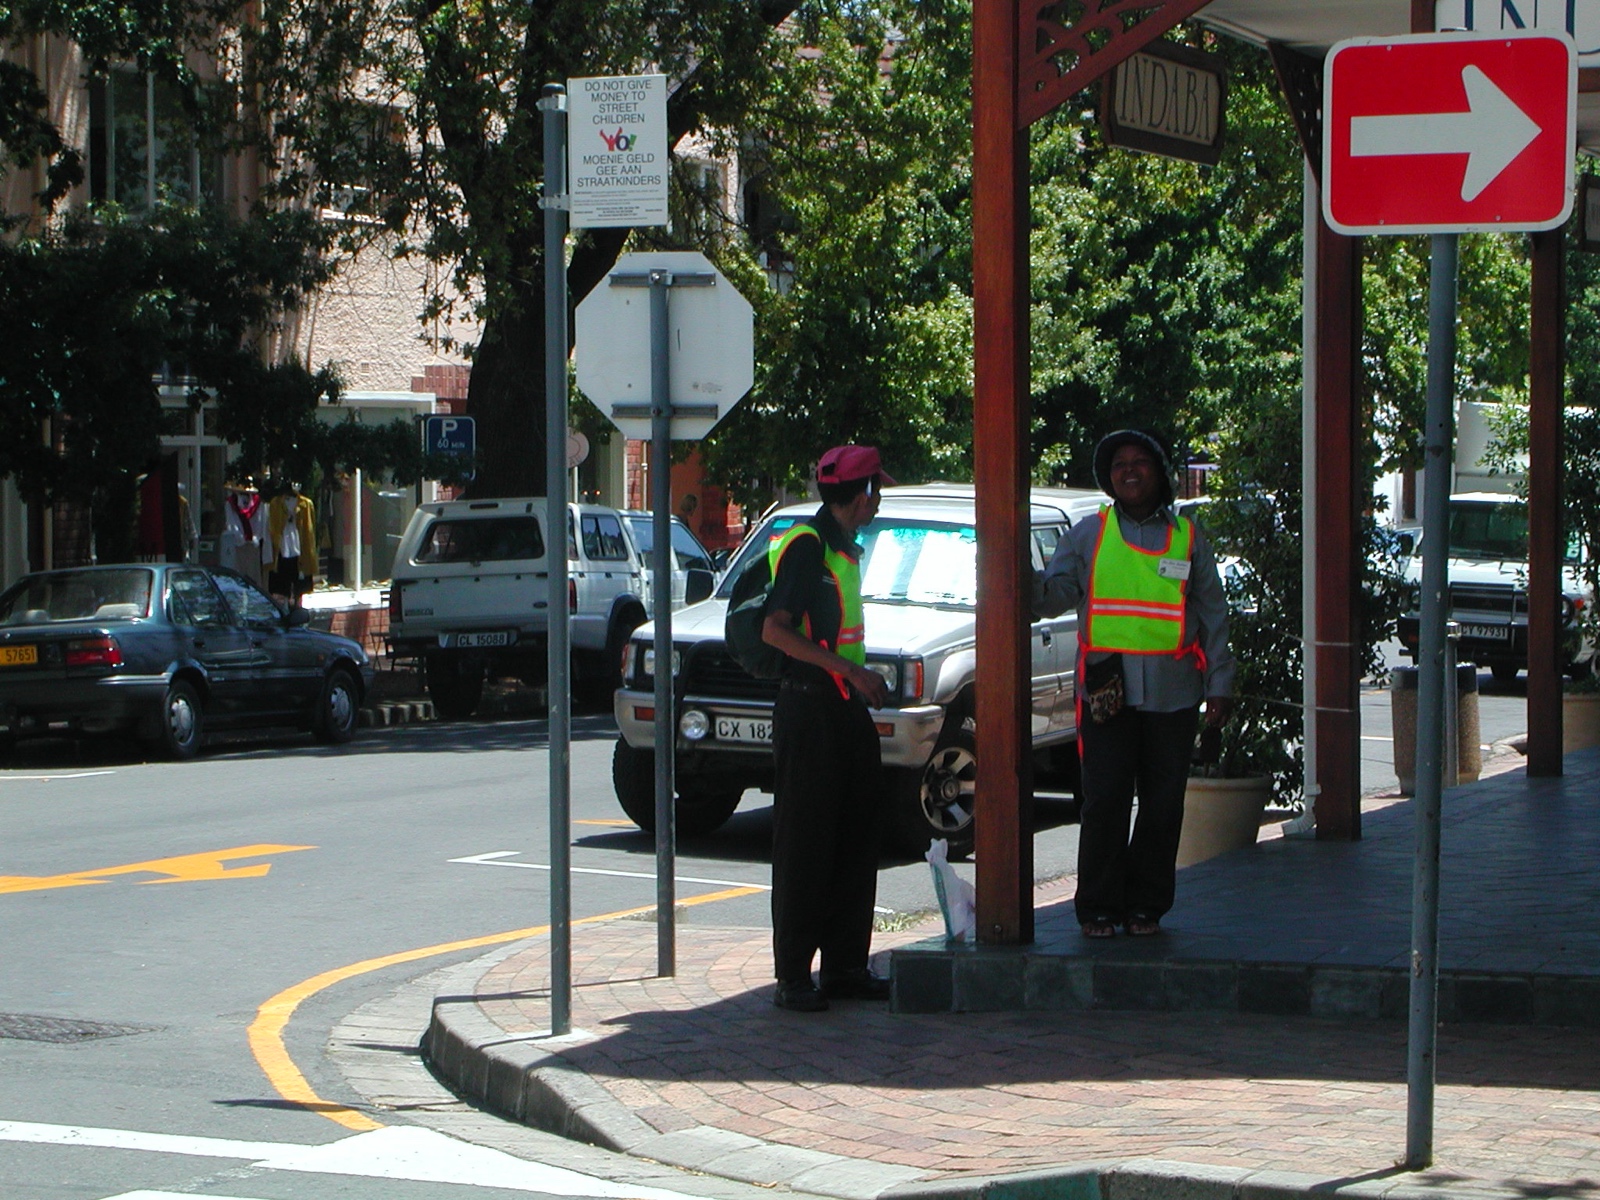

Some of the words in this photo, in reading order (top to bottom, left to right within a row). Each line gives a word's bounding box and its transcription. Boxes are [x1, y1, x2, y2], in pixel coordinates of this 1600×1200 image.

[584, 81, 601, 92] DO
[603, 80, 626, 91] NOT
[627, 79, 652, 90] GIVE
[591, 91, 629, 103] MONEY
[631, 90, 646, 101] TO
[1119, 56, 1210, 140] INDABA
[598, 102, 638, 113] STREET
[592, 113, 645, 125] CHILDREN
[583, 154, 623, 165] MOENIE
[626, 153, 655, 164] GELD
[596, 165, 618, 176] GEE
[620, 164, 642, 175] AAN
[577, 175, 661, 188] STRAATKINDERS
[442, 419, 458, 438] P
[437, 439, 449, 449] 60
[459, 635, 473, 646] CL
[476, 634, 506, 646] 15088
[5, 647, 35, 662] 57651
[718, 720, 741, 738] CX
